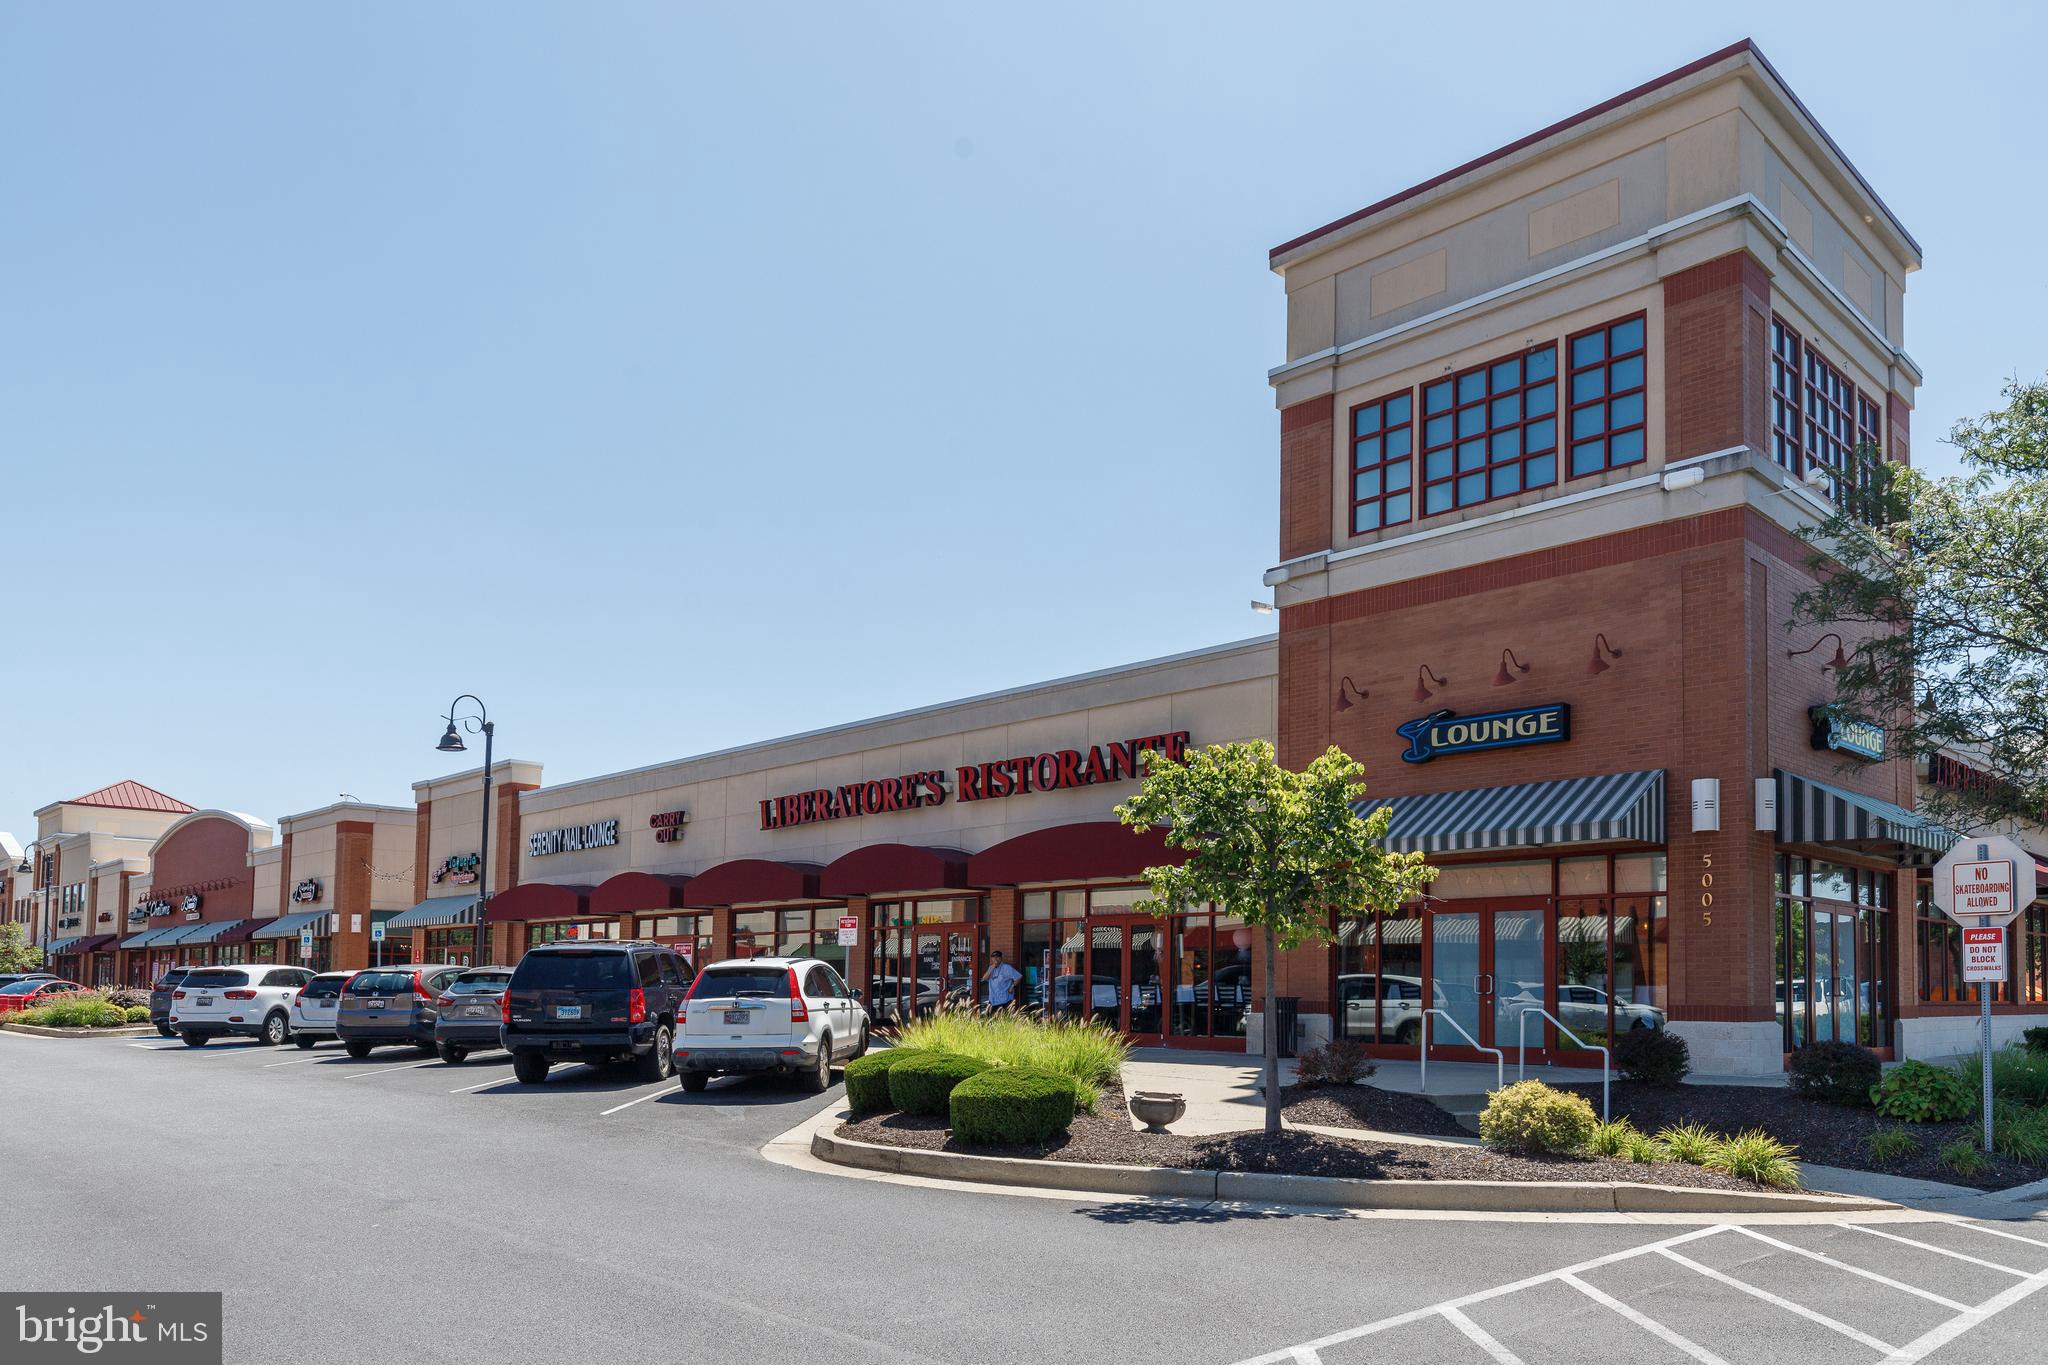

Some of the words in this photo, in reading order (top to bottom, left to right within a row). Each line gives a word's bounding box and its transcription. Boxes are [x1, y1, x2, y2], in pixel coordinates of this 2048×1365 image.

[1430, 711, 1560, 747] LOUNGE
[1841, 721, 1883, 753] LOUNGE
[759, 770, 945, 831] LIBERATORE'S
[956, 731, 1190, 803] RISTORANTE
[649, 811, 683, 828] CARRY
[529, 829, 562, 857] SERENITY
[564, 825, 582, 851] NAIL
[584, 820, 617, 848] LOUNGE
[655, 827, 675, 843] OUT
[1975, 867, 1988, 880] NO
[1702, 853, 1713, 926] 5005
[1955, 882, 2010, 895] SKATEBOARDING
[1966, 896, 1998, 907] ALLOWED
[1970, 933, 1996, 941] PLEASE
